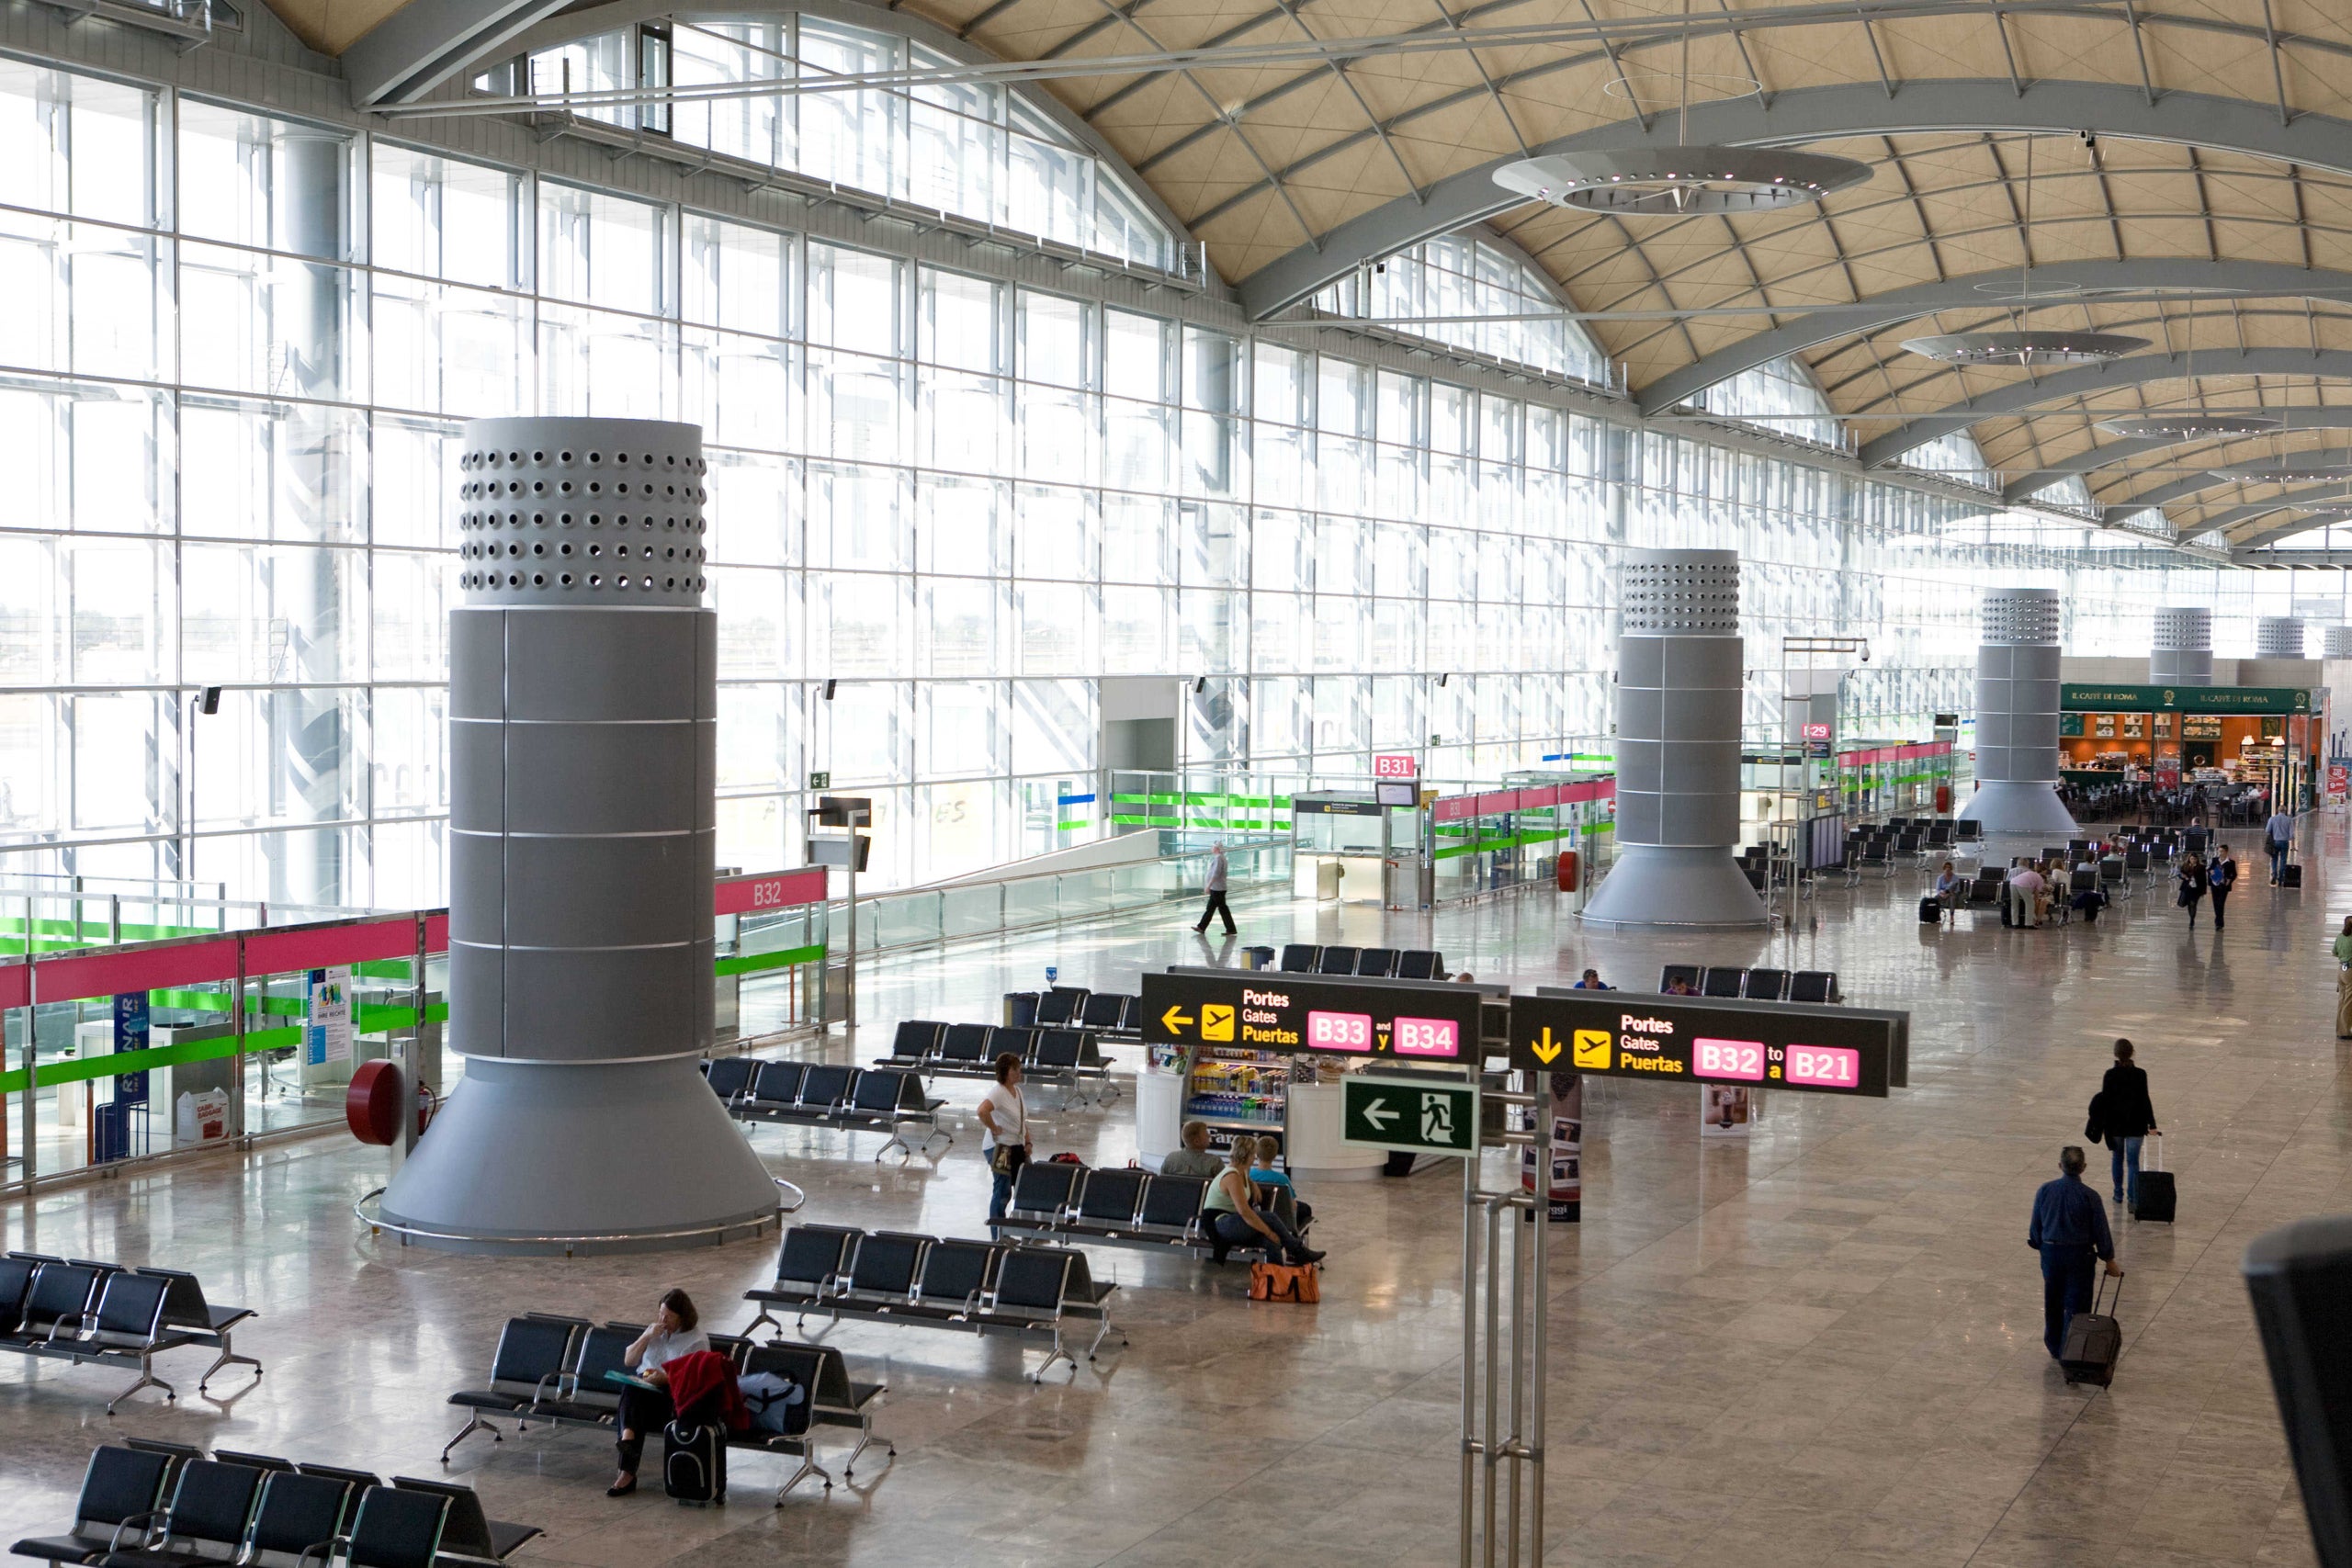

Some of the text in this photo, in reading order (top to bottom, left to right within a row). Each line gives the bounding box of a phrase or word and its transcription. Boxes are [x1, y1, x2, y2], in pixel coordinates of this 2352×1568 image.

[1379, 759, 1408, 774] B31
[753, 881, 781, 907] B32
[1242, 988, 1290, 1008] Portes
[1242, 1010, 1278, 1025] Gates
[1620, 1014, 1674, 1035] Portes
[1242, 1025, 1299, 1045] Puertas
[1316, 1018, 1453, 1051] B33 and B34
[1378, 1032, 1389, 1052] y
[1620, 1034, 1660, 1052] Gates
[122, 998, 133, 1093] RYNAIR
[1620, 1053, 1684, 1074] Puertas
[1702, 1044, 1851, 1081] B32 to B21
[1769, 1063, 1781, 1079] a
[1547, 1204, 1568, 1215] rggi
